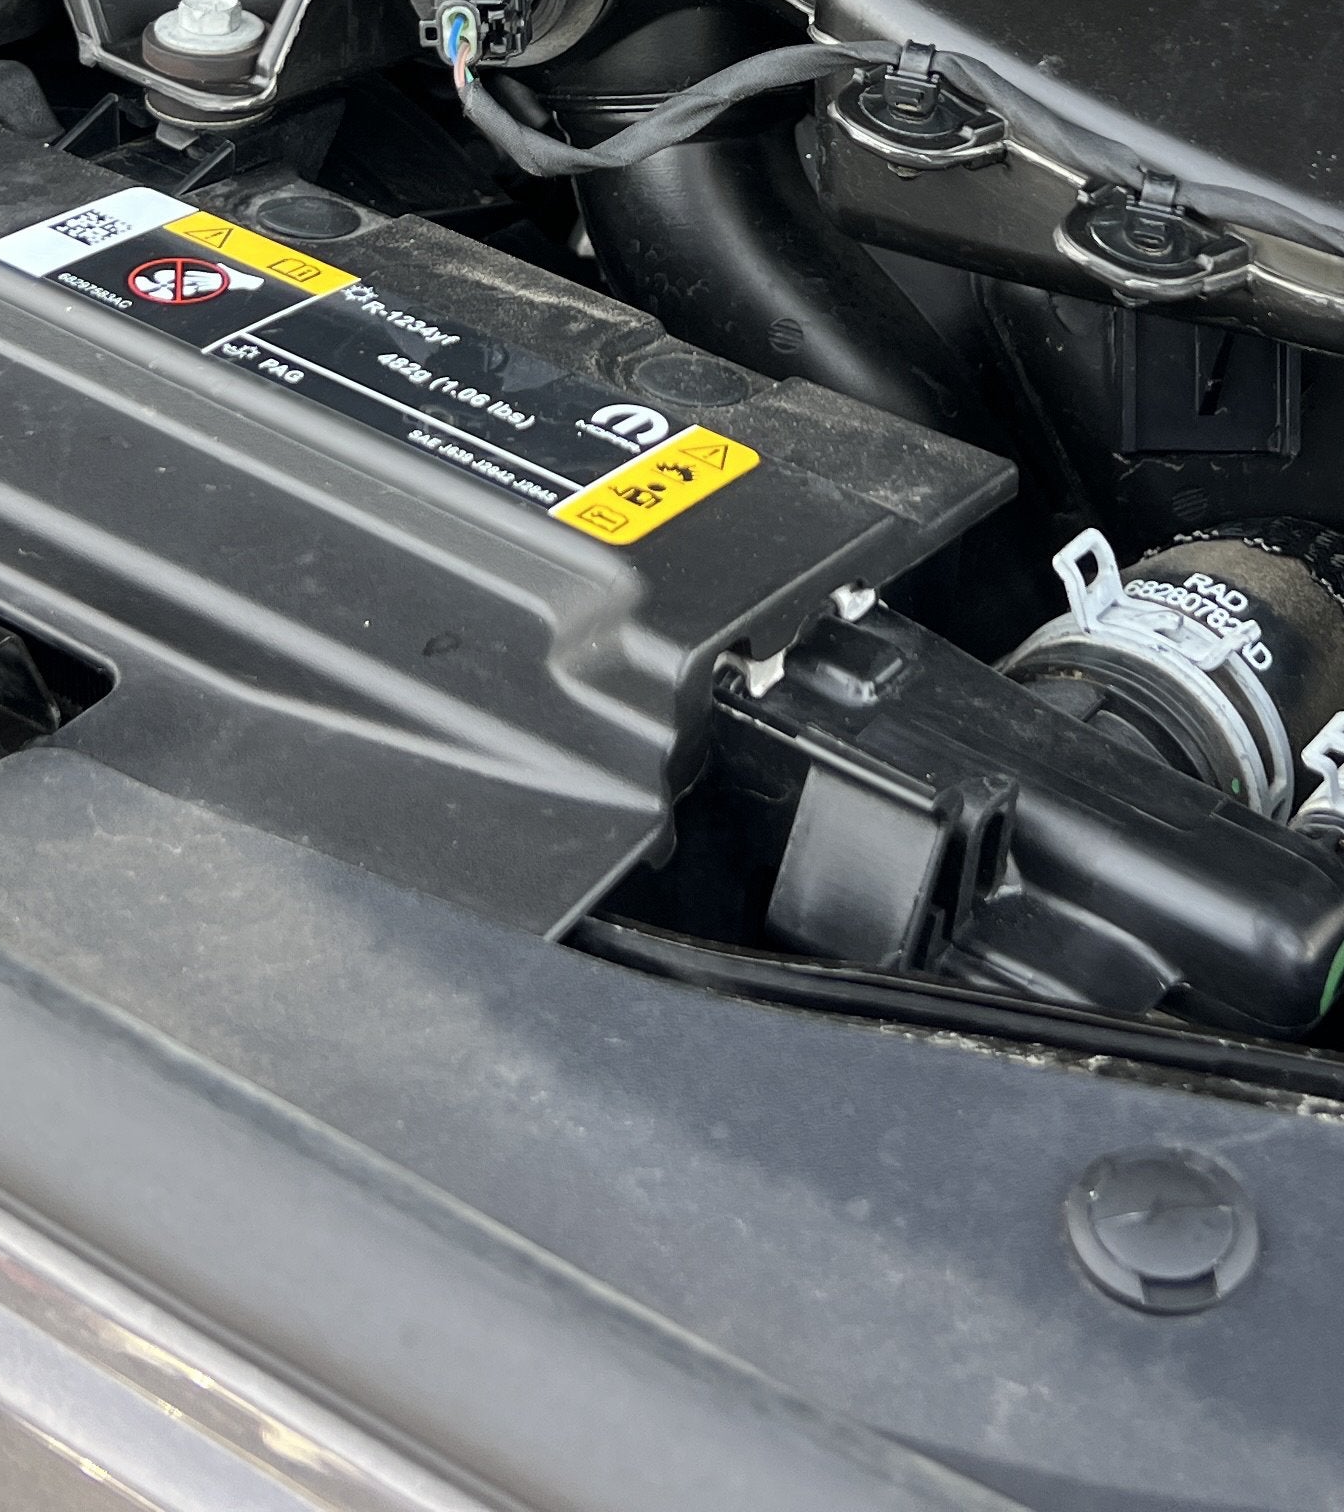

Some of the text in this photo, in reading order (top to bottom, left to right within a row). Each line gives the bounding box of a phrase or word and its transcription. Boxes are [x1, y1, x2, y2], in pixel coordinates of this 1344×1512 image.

[362, 300, 461, 346] R-1234yf
[258, 358, 305, 384] PAG
[377, 353, 536, 430] 482g (1.06 lbs)
[407, 429, 442, 449] SAE
[1183, 572, 1249, 613] RAD
[1124, 579, 1273, 671] 68280782D
